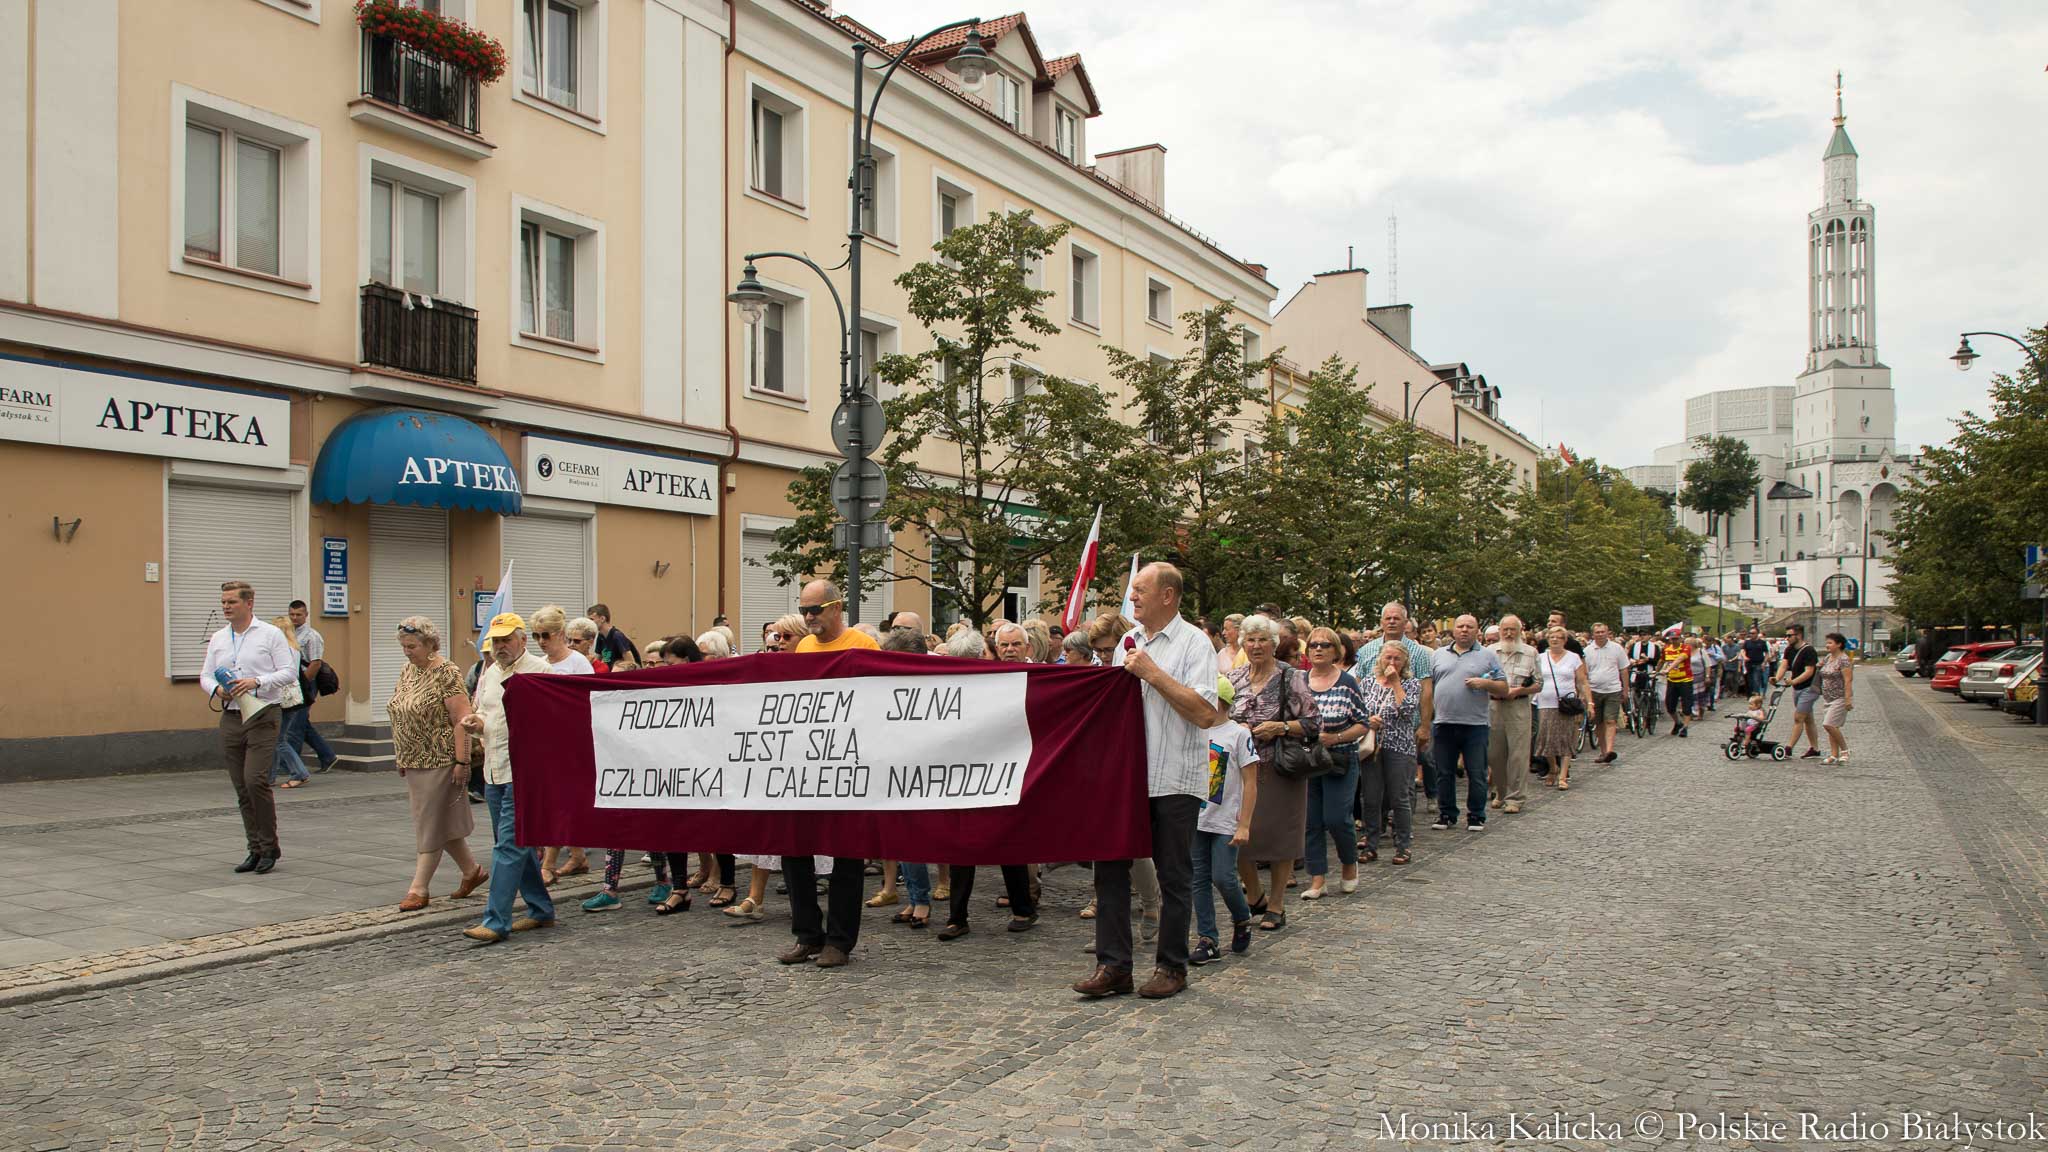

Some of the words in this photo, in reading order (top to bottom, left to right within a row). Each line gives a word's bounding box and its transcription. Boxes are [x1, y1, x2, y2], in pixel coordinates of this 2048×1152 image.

[96, 396, 268, 447] APTEKA
[398, 456, 522, 494] APTEKA
[558, 461, 600, 477] CEFARM
[622, 467, 713, 501] APTEKA
[618, 696, 715, 730] RODZINA
[758, 689, 855, 726] BOGIEM
[886, 686, 963, 721] SILNA
[728, 729, 794, 763] JEST
[805, 727, 860, 765] SIŁĄ
[598, 766, 724, 798] CZŁOWIEKA
[743, 767, 752, 798] I
[765, 766, 870, 799] CAŁEGO
[887, 761, 1018, 799] NARODU!
